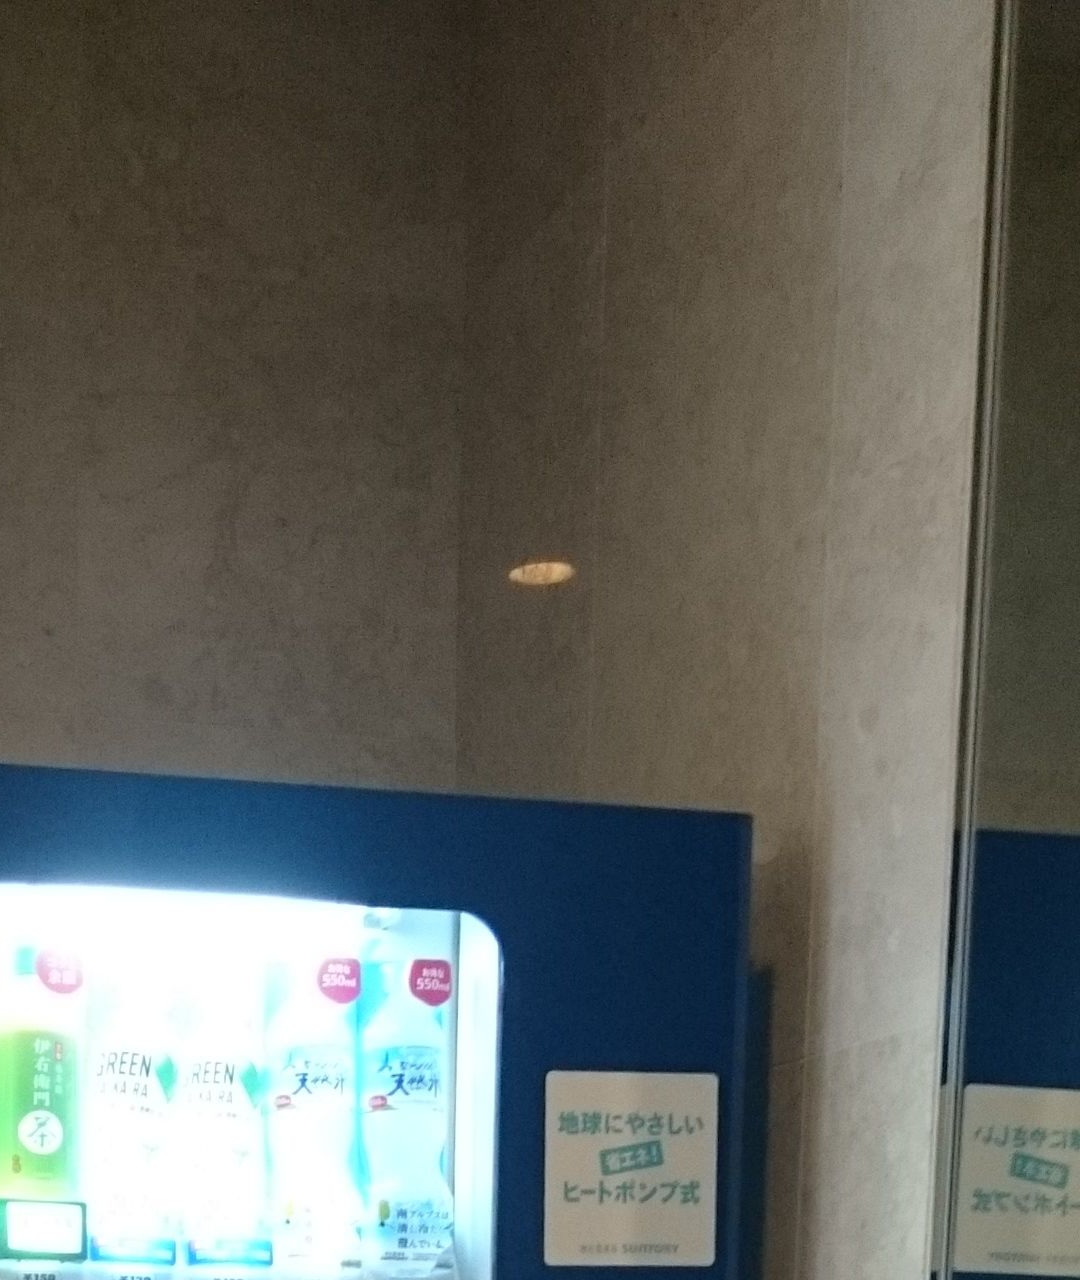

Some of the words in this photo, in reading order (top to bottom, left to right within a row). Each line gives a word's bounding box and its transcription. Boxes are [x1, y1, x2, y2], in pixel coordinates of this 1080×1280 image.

[186, 1062, 235, 1085] REEN
[558, 1111, 705, 1135] 地球にやさしい
[563, 1180, 701, 1205] ヒートポンプ式
